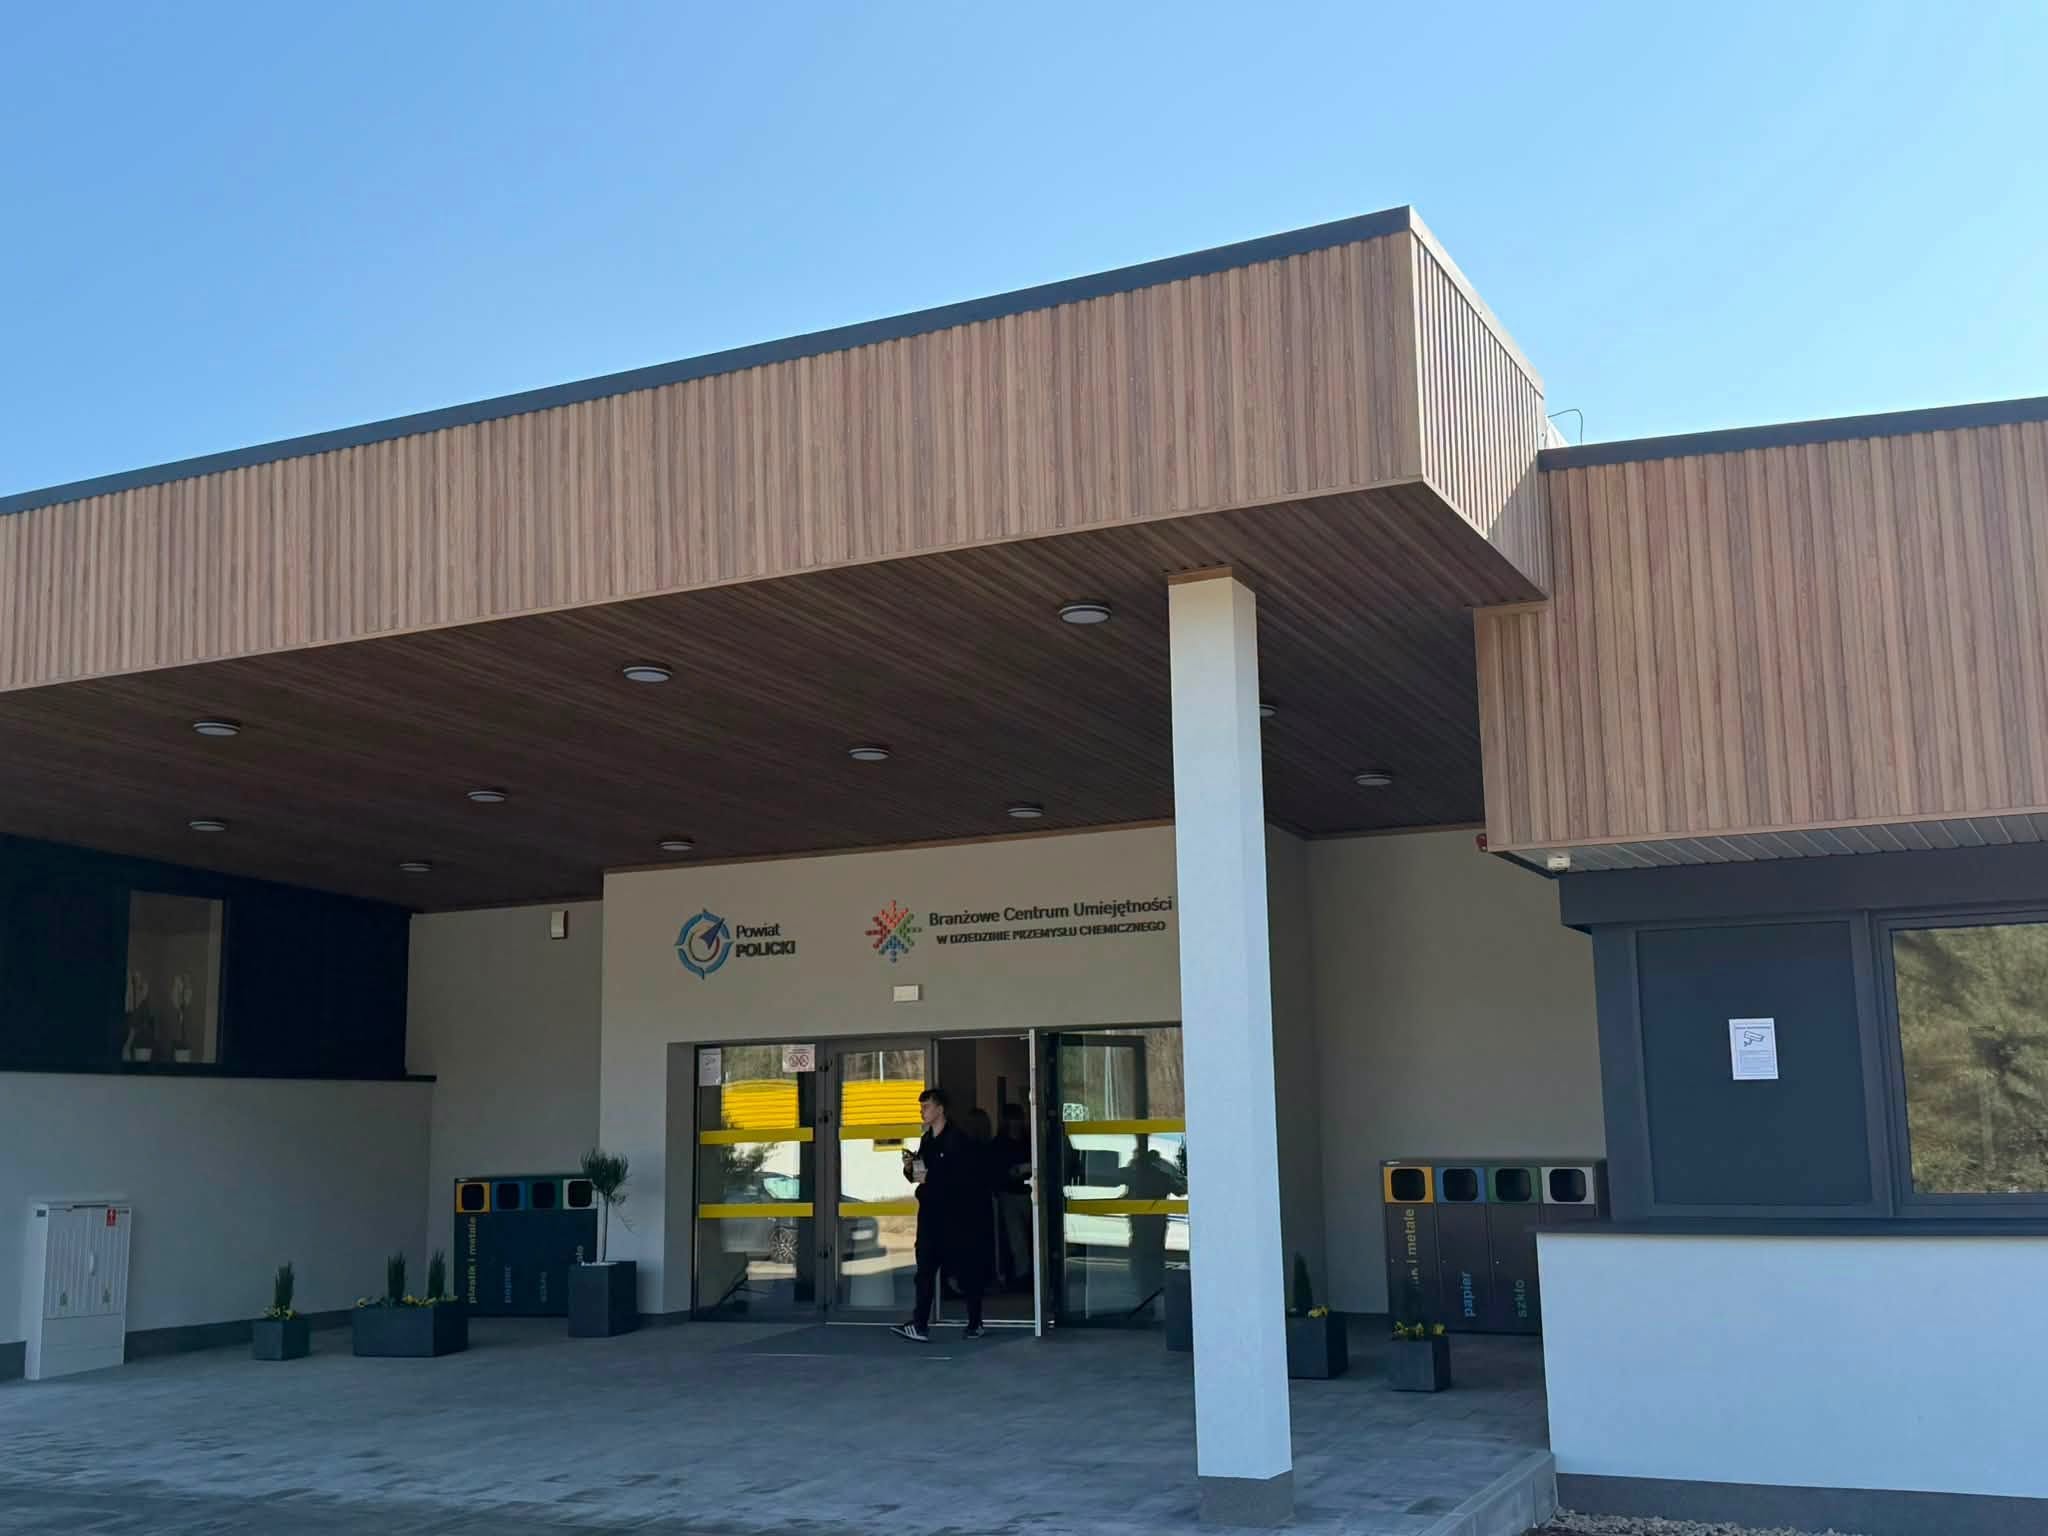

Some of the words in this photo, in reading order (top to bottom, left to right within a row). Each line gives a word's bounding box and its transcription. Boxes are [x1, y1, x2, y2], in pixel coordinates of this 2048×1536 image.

[929, 909, 1000, 926] Branżowe
[1003, 906, 1069, 922] Centrum
[1073, 896, 1172, 918] Umiejętności
[736, 923, 781, 939] Powiat
[950, 930, 1011, 944] DZIEDZINIE
[1079, 920, 1166, 936] CHEMICZNEGO
[736, 940, 796, 957] POLICKI
[1404, 1208, 1417, 1256] metale
[1460, 1271, 1477, 1318] papier
